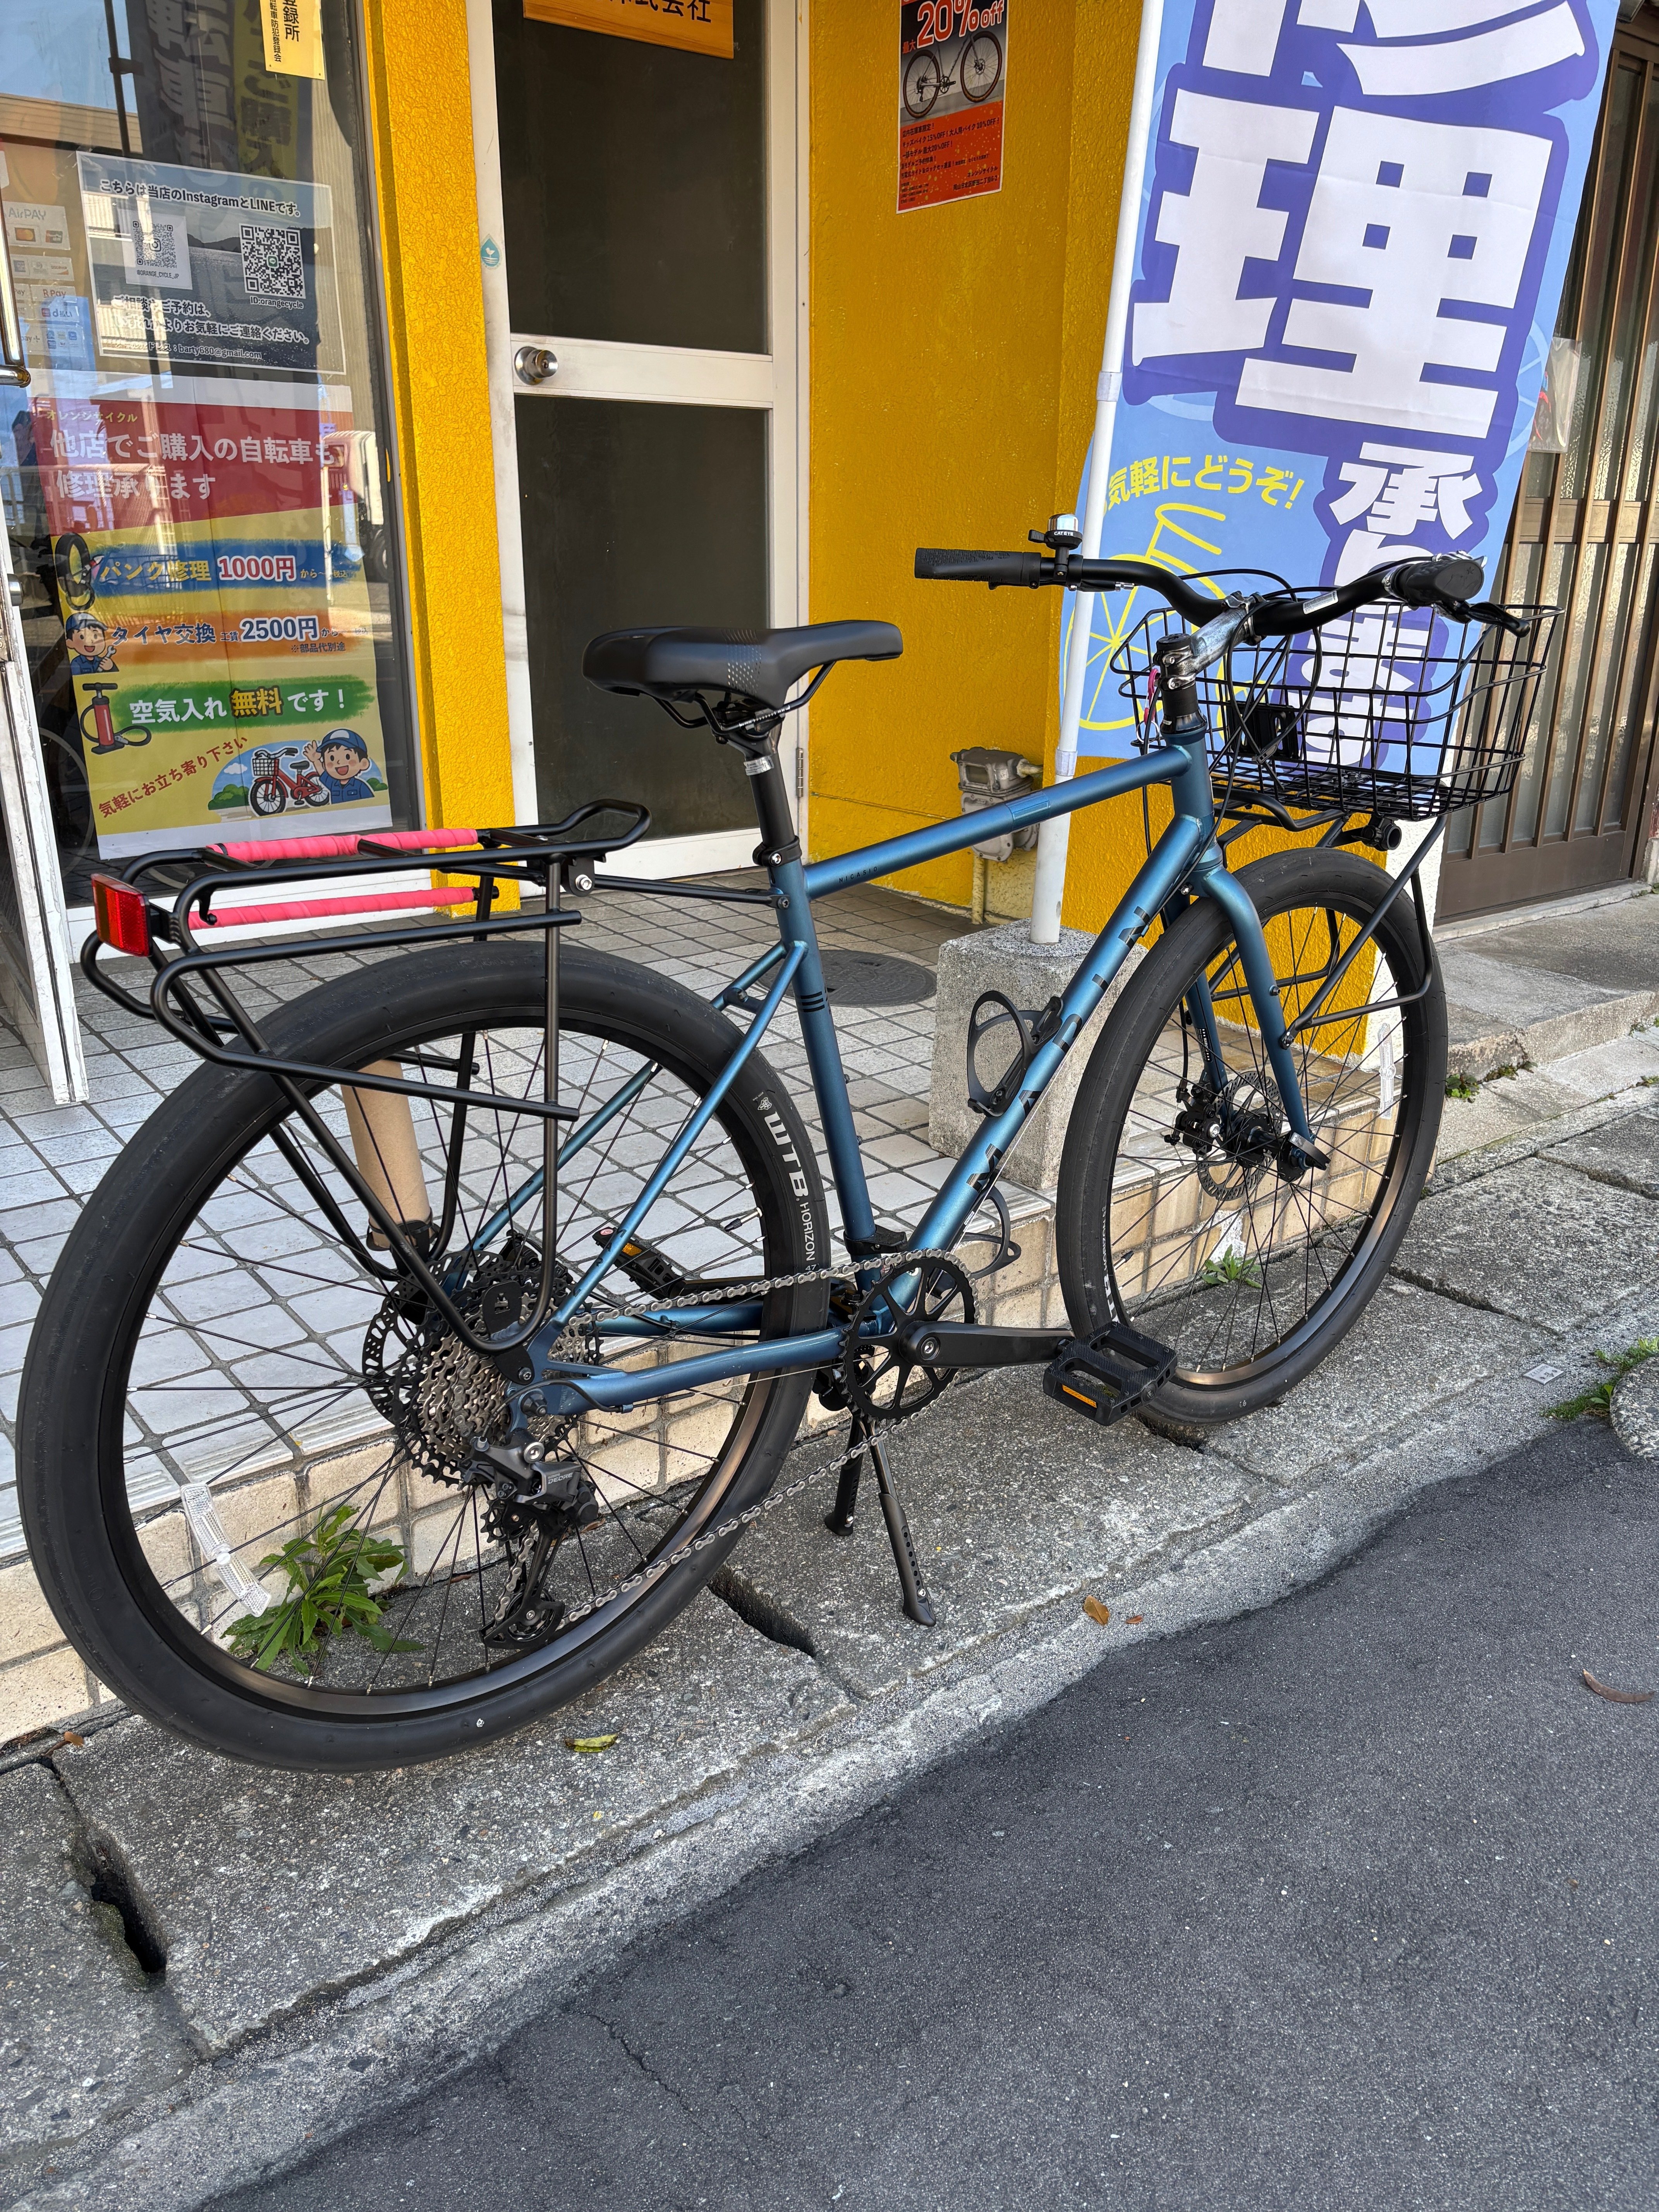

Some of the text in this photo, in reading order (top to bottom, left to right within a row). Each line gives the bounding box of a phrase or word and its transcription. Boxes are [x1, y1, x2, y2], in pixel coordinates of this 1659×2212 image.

[270, 0, 282, 62] 転車防犯登録会
[250, 296, 304, 309] ID:orangecycle
[50, 429, 334, 464] 他店でご購入の自転車も
[1103, 455, 1305, 517] 気軽にどうぞ!
[100, 560, 212, 582] パンク修理
[218, 556, 297, 581] 1000円
[112, 622, 216, 646] タイヤ交換
[240, 615, 319, 642] 2500円
[129, 687, 345, 724] 空気入れ 無料 です！
[99, 737, 247, 818] 気軽にお立ち寄り下さい
[839, 867, 877, 883] NICASIO
[764, 1111, 809, 1197] WTB
[799, 1202, 815, 1261] HORIZON
[548, 1472, 573, 1484] DEORE
